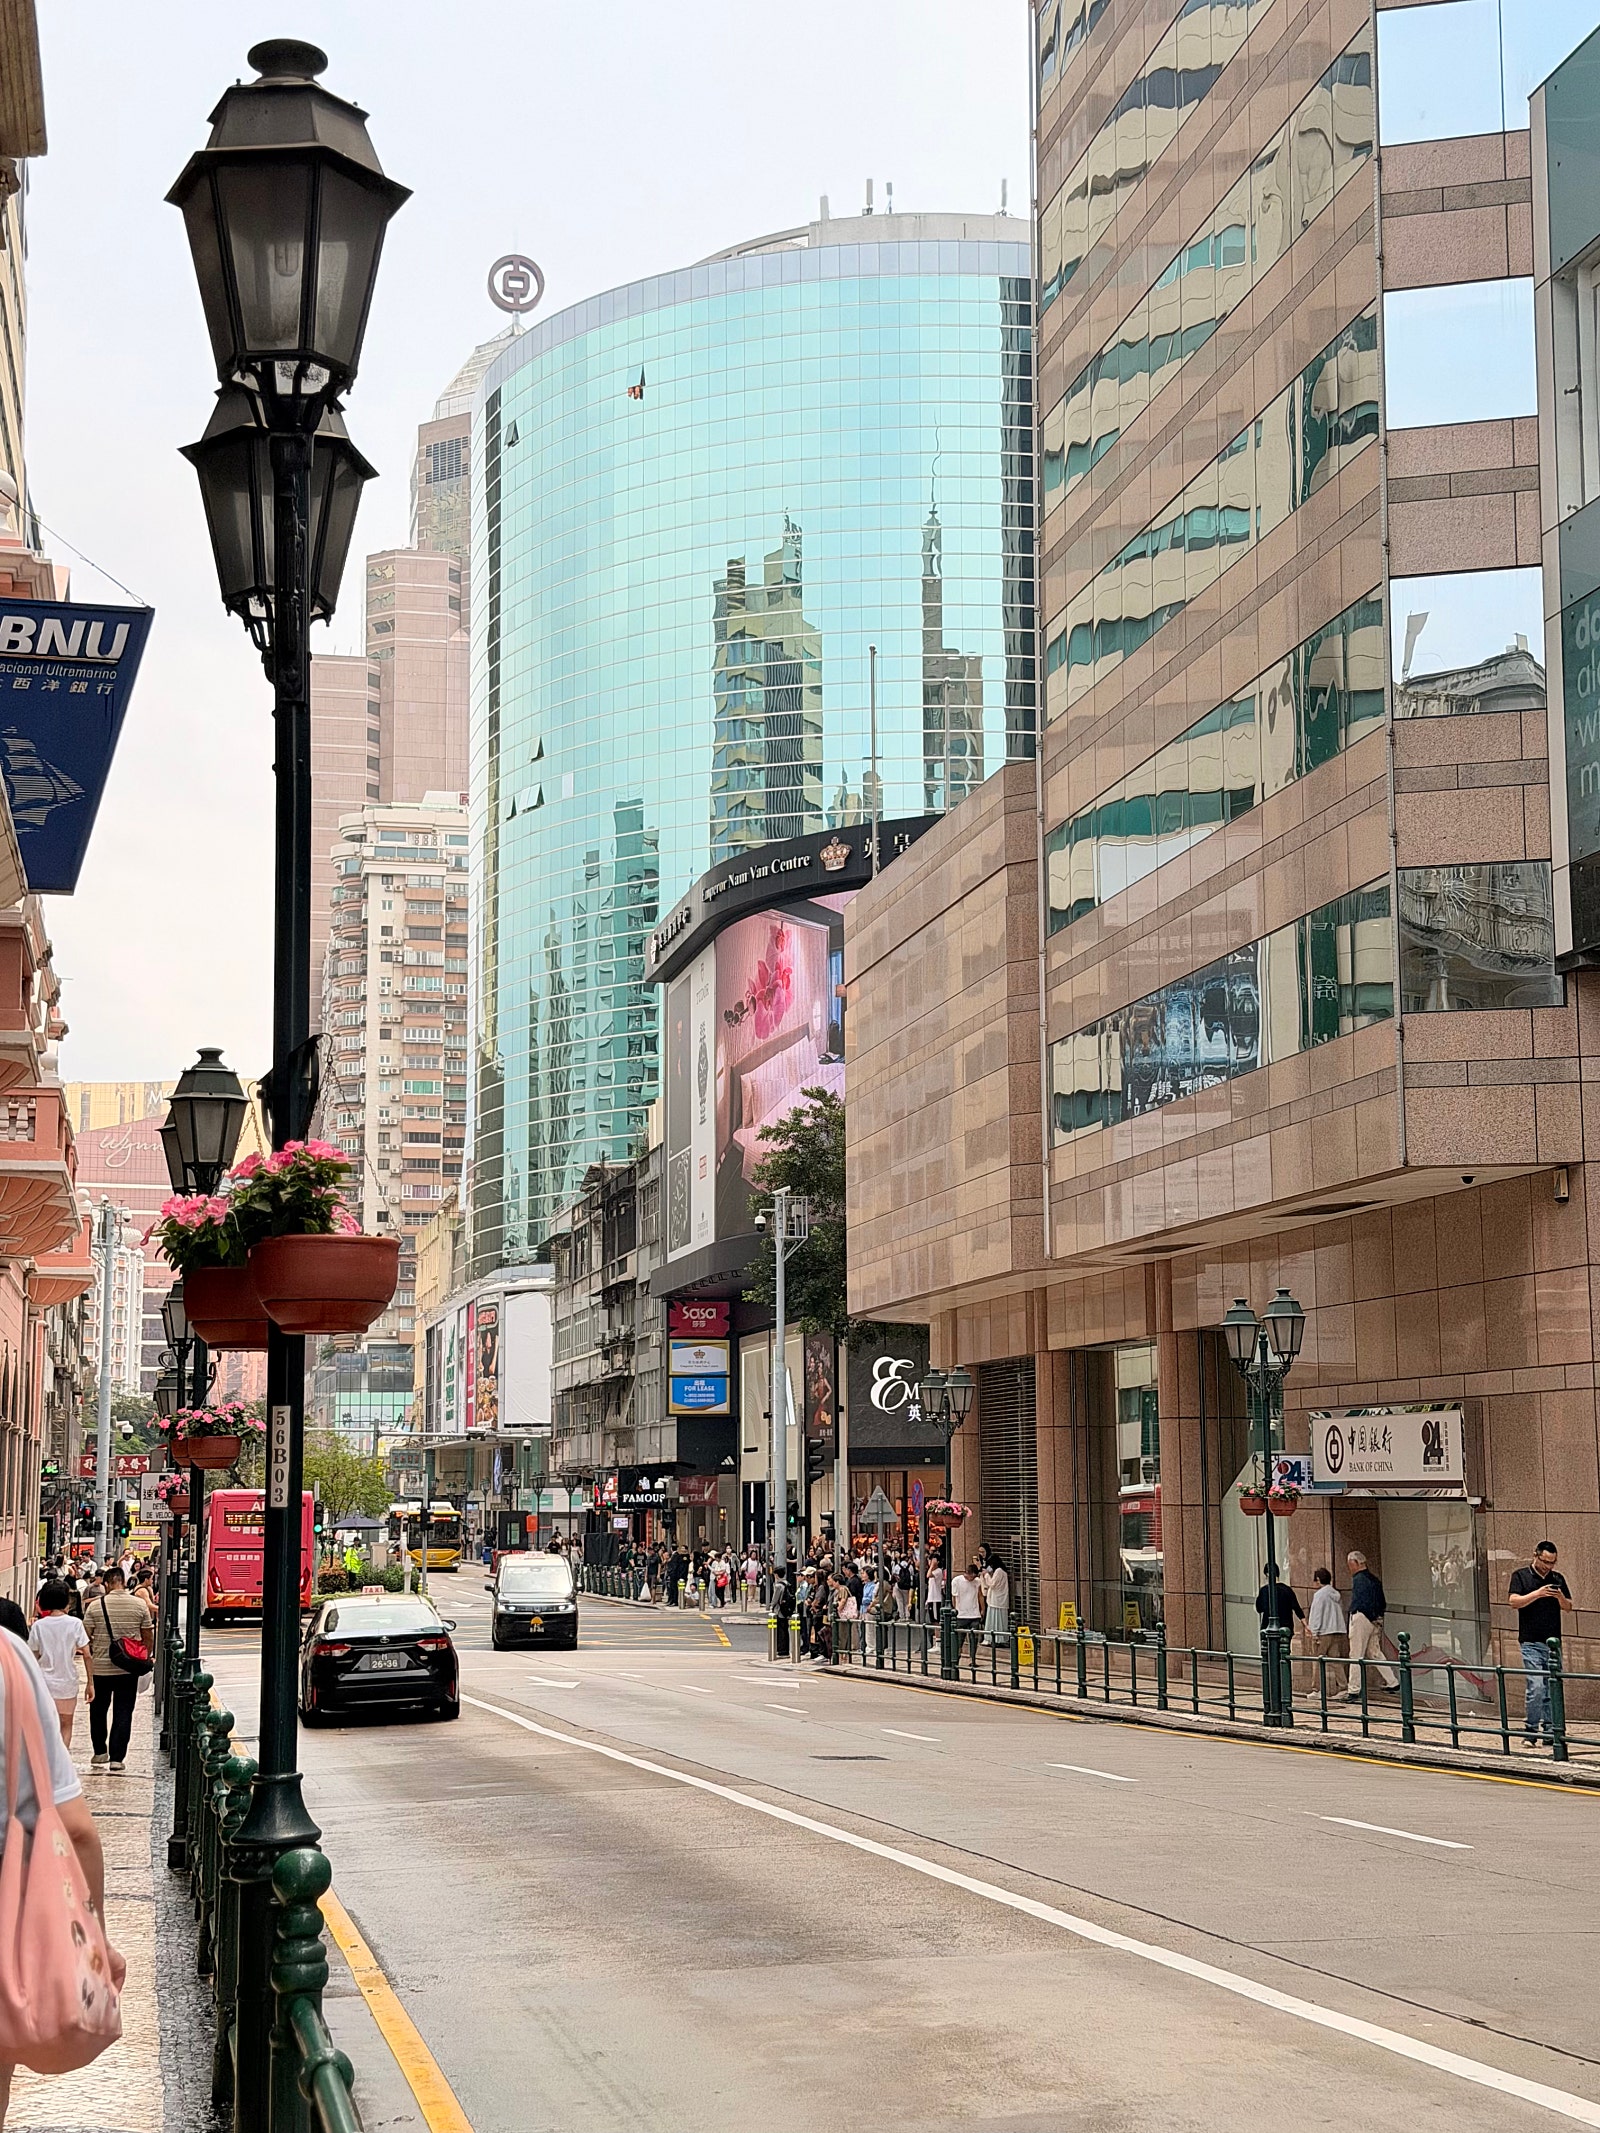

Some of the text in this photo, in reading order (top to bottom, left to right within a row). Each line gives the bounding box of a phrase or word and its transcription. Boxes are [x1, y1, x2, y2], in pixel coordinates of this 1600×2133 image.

[0, 616, 130, 659] BNU
[0, 663, 117, 679] acional Ultramarino
[702, 855, 811, 902] Emperor Nam Van Centre
[273, 1410, 287, 1503] 56B03
[1349, 1461, 1394, 1472] BANK OF CHINA
